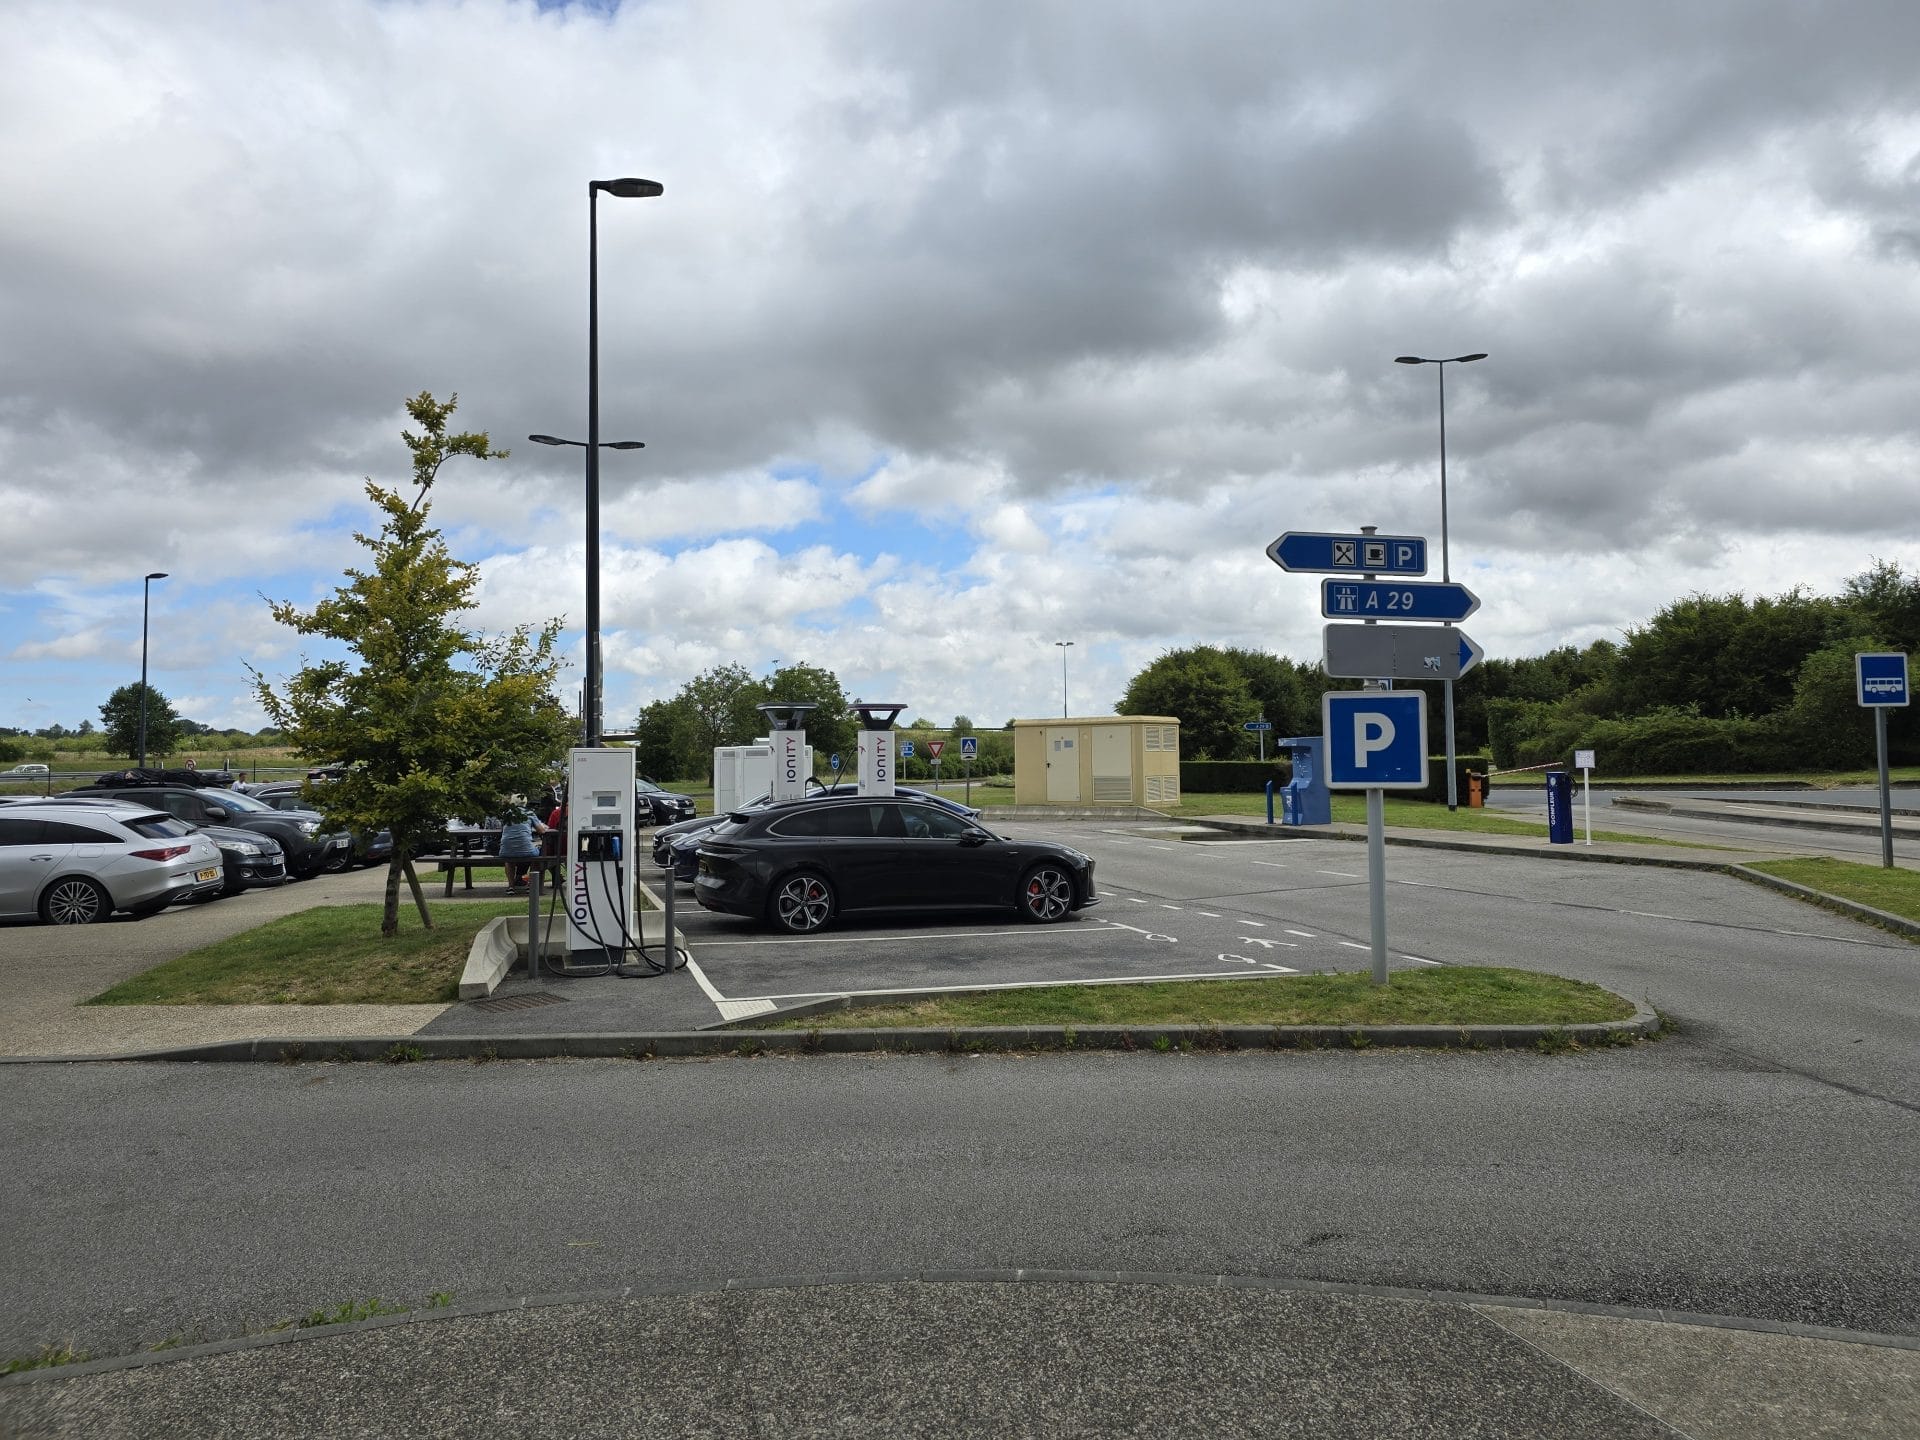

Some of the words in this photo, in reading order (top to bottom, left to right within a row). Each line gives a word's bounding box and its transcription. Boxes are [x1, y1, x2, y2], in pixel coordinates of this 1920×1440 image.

[1398, 546, 1412, 566] P
[1365, 591, 1379, 609] A
[1386, 591, 1414, 610] 29
[786, 737, 796, 783] IONITY
[877, 737, 886, 782] IONITY
[1354, 712, 1395, 769] P
[574, 863, 588, 926] IONITY
